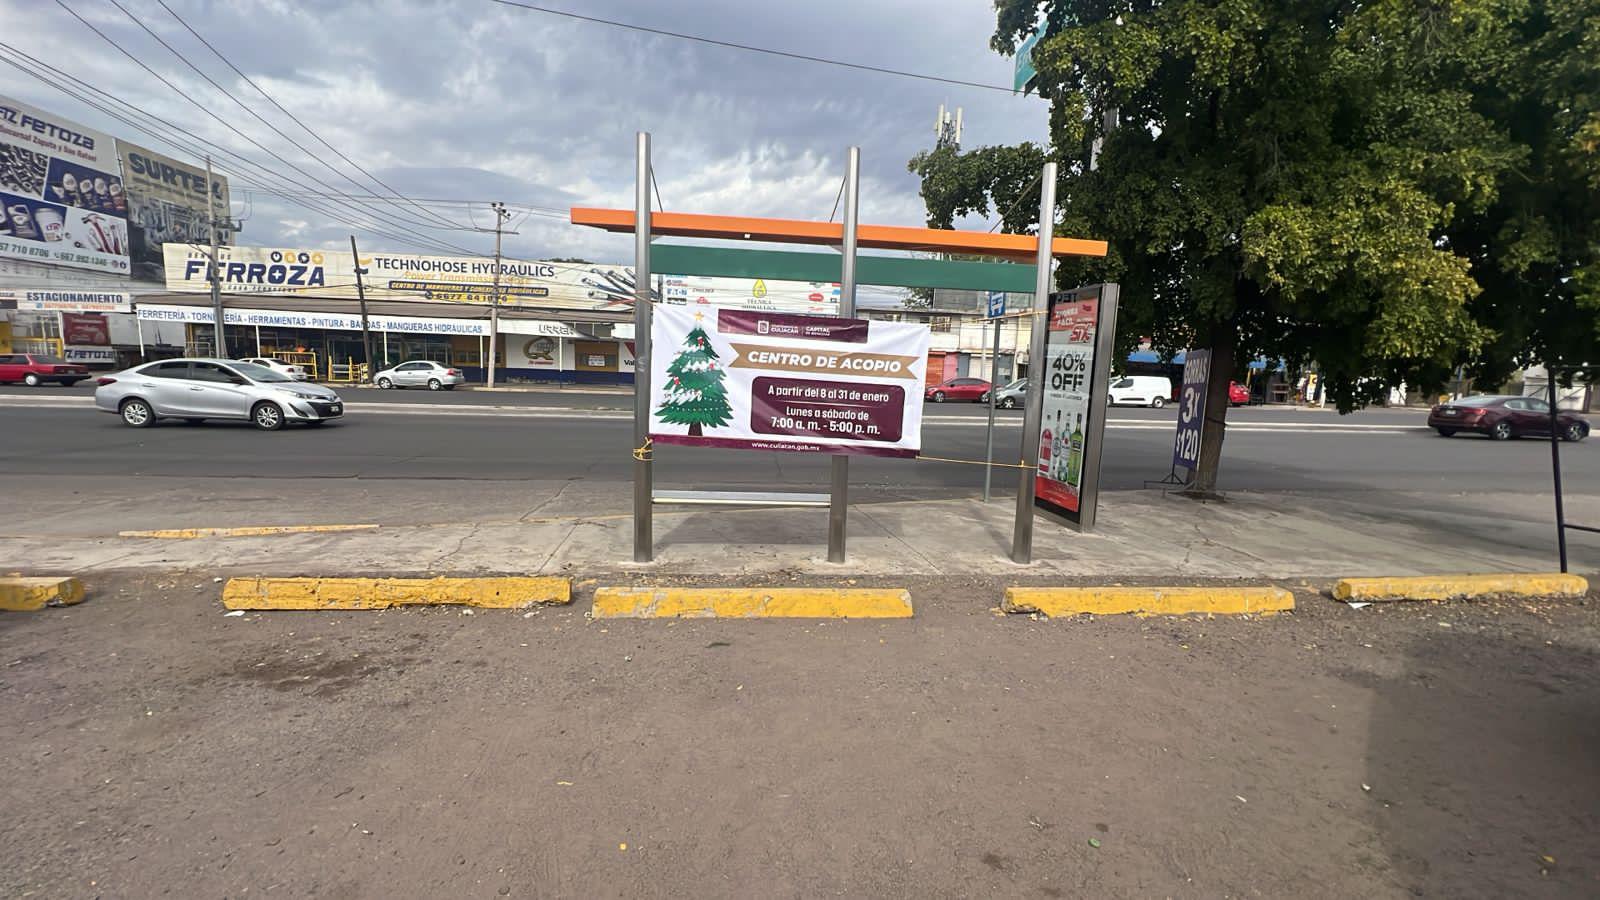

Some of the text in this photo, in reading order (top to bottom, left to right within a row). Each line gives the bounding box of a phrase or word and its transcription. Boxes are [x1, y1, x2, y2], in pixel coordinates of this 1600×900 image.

[185, 260, 324, 286] FERROZA
[375, 258, 554, 278] TECHNOHOSE HYDRAULICS
[27, 292, 122, 303] ESTACIONAMIENTO
[249, 314, 306, 326] HERRAMIENTAS
[313, 318, 344, 328] PINTURA
[387, 322, 432, 331] MANGUERAS
[748, 351, 901, 372] CENTRO DE ACOPIO
[1052, 353, 1086, 371] 40%
[1052, 373, 1084, 391] OFF
[768, 385, 889, 402] A partir del 8 al 31 de enero
[786, 406, 869, 420] Lunes a sábado de
[771, 416, 793, 428] 7:00
[796, 419, 806, 429] a.
[808, 421, 821, 430] m.
[830, 421, 852, 432] 5:00
[855, 423, 865, 434] p.
[867, 425, 880, 435] m.
[1176, 429, 1199, 461] $120
